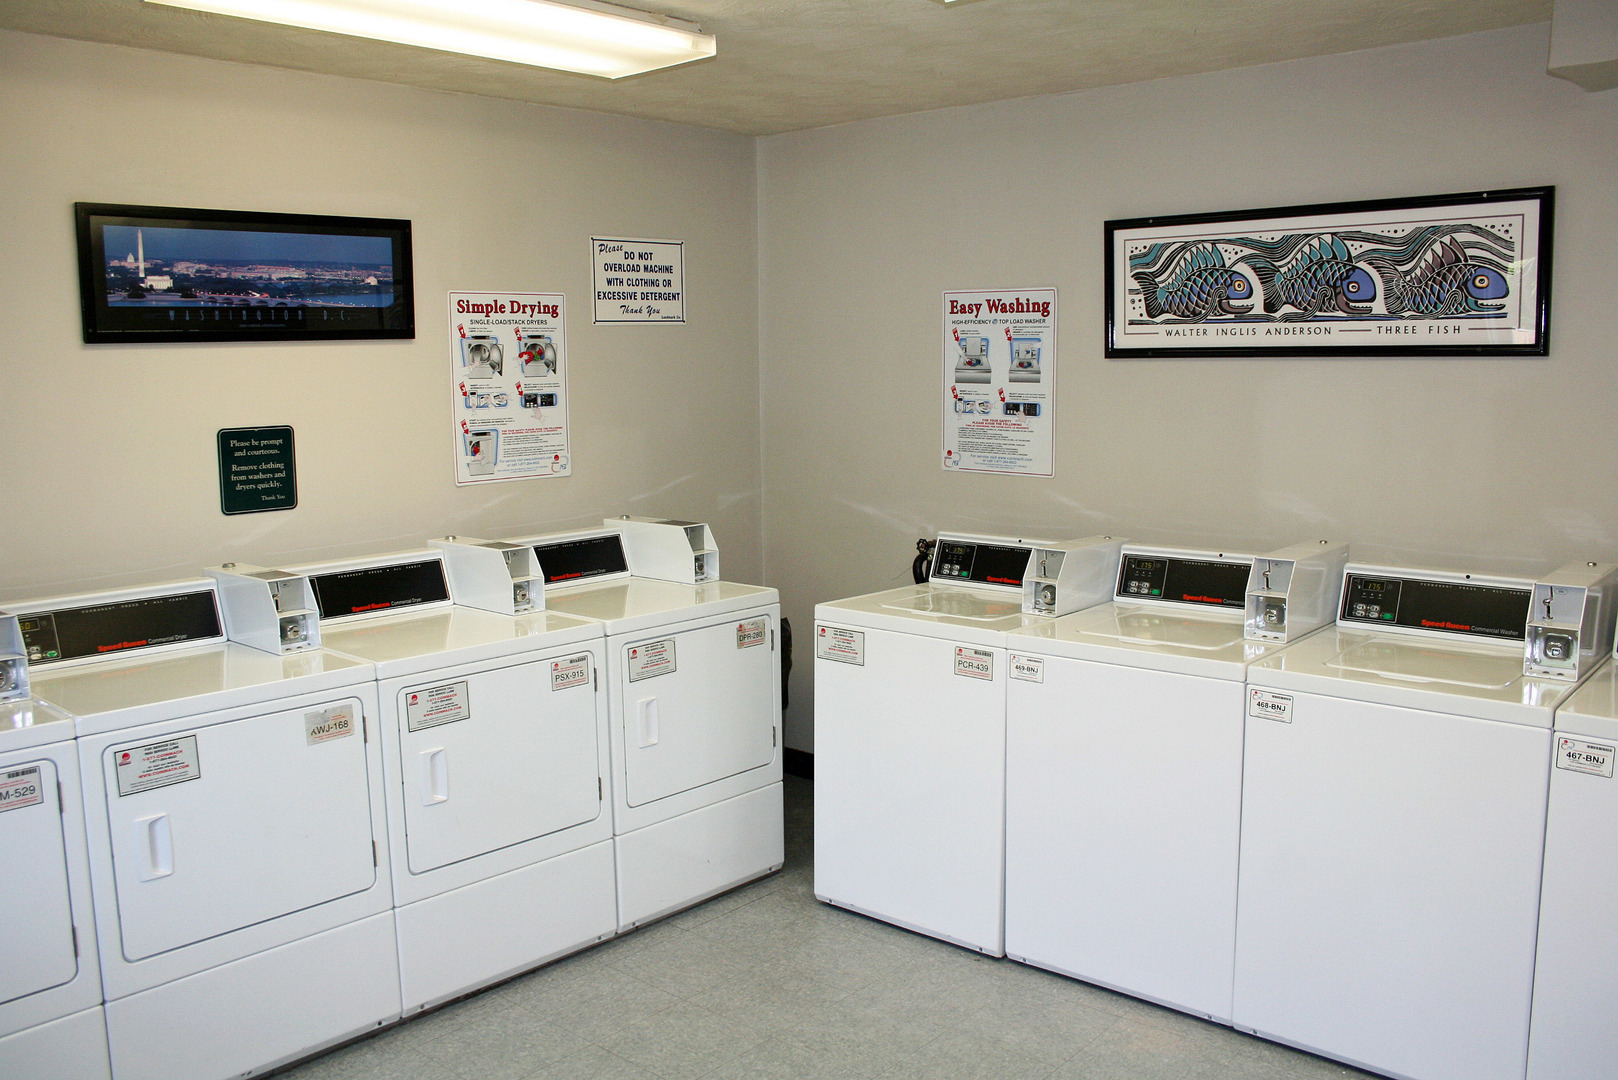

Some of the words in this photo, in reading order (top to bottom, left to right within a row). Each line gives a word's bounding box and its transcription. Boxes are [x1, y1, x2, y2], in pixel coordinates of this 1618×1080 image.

[598, 244, 623, 255] Please
[624, 252, 635, 260] DO
[639, 252, 653, 260] NOT
[604, 263, 640, 272] OVERLOAD
[644, 264, 673, 273] MACHINE
[606, 278, 624, 286] WITH
[626, 278, 660, 287] CLOTHING
[597, 291, 637, 300] EXCESSIVE
[641, 292, 680, 300] DETERGENT
[457, 300, 506, 317] Simple
[510, 300, 559, 318] Drying
[620, 305, 642, 314] Thank
[646, 305, 660, 317] You
[949, 300, 982, 318] Easy
[985, 297, 1050, 317] Washing
[169, 310, 302, 320] WASHINGTON
[1216, 328, 1257, 336] INGLIS
[1265, 327, 1331, 336] ANDERSON
[1377, 326, 1417, 334] THREE
[1429, 325, 1461, 334] FISH
[257, 480, 282, 490] quickly.
[352, 604, 371, 612] Speed
[1421, 619, 1445, 627] Speed
[1446, 621, 1471, 630] Queen
[1471, 626, 1500, 634] Commercial
[98, 642, 122, 652] Speed
[122, 640, 148, 649] Queen
[148, 636, 174, 644] Commercial
[958, 660, 988, 672] PCR-439
[1015, 664, 1038, 673] 469-BNJ
[555, 670, 584, 682] PSX-915
[1257, 701, 1286, 711] 468-BNJ
[1566, 752, 1605, 764] 467-BNJ
